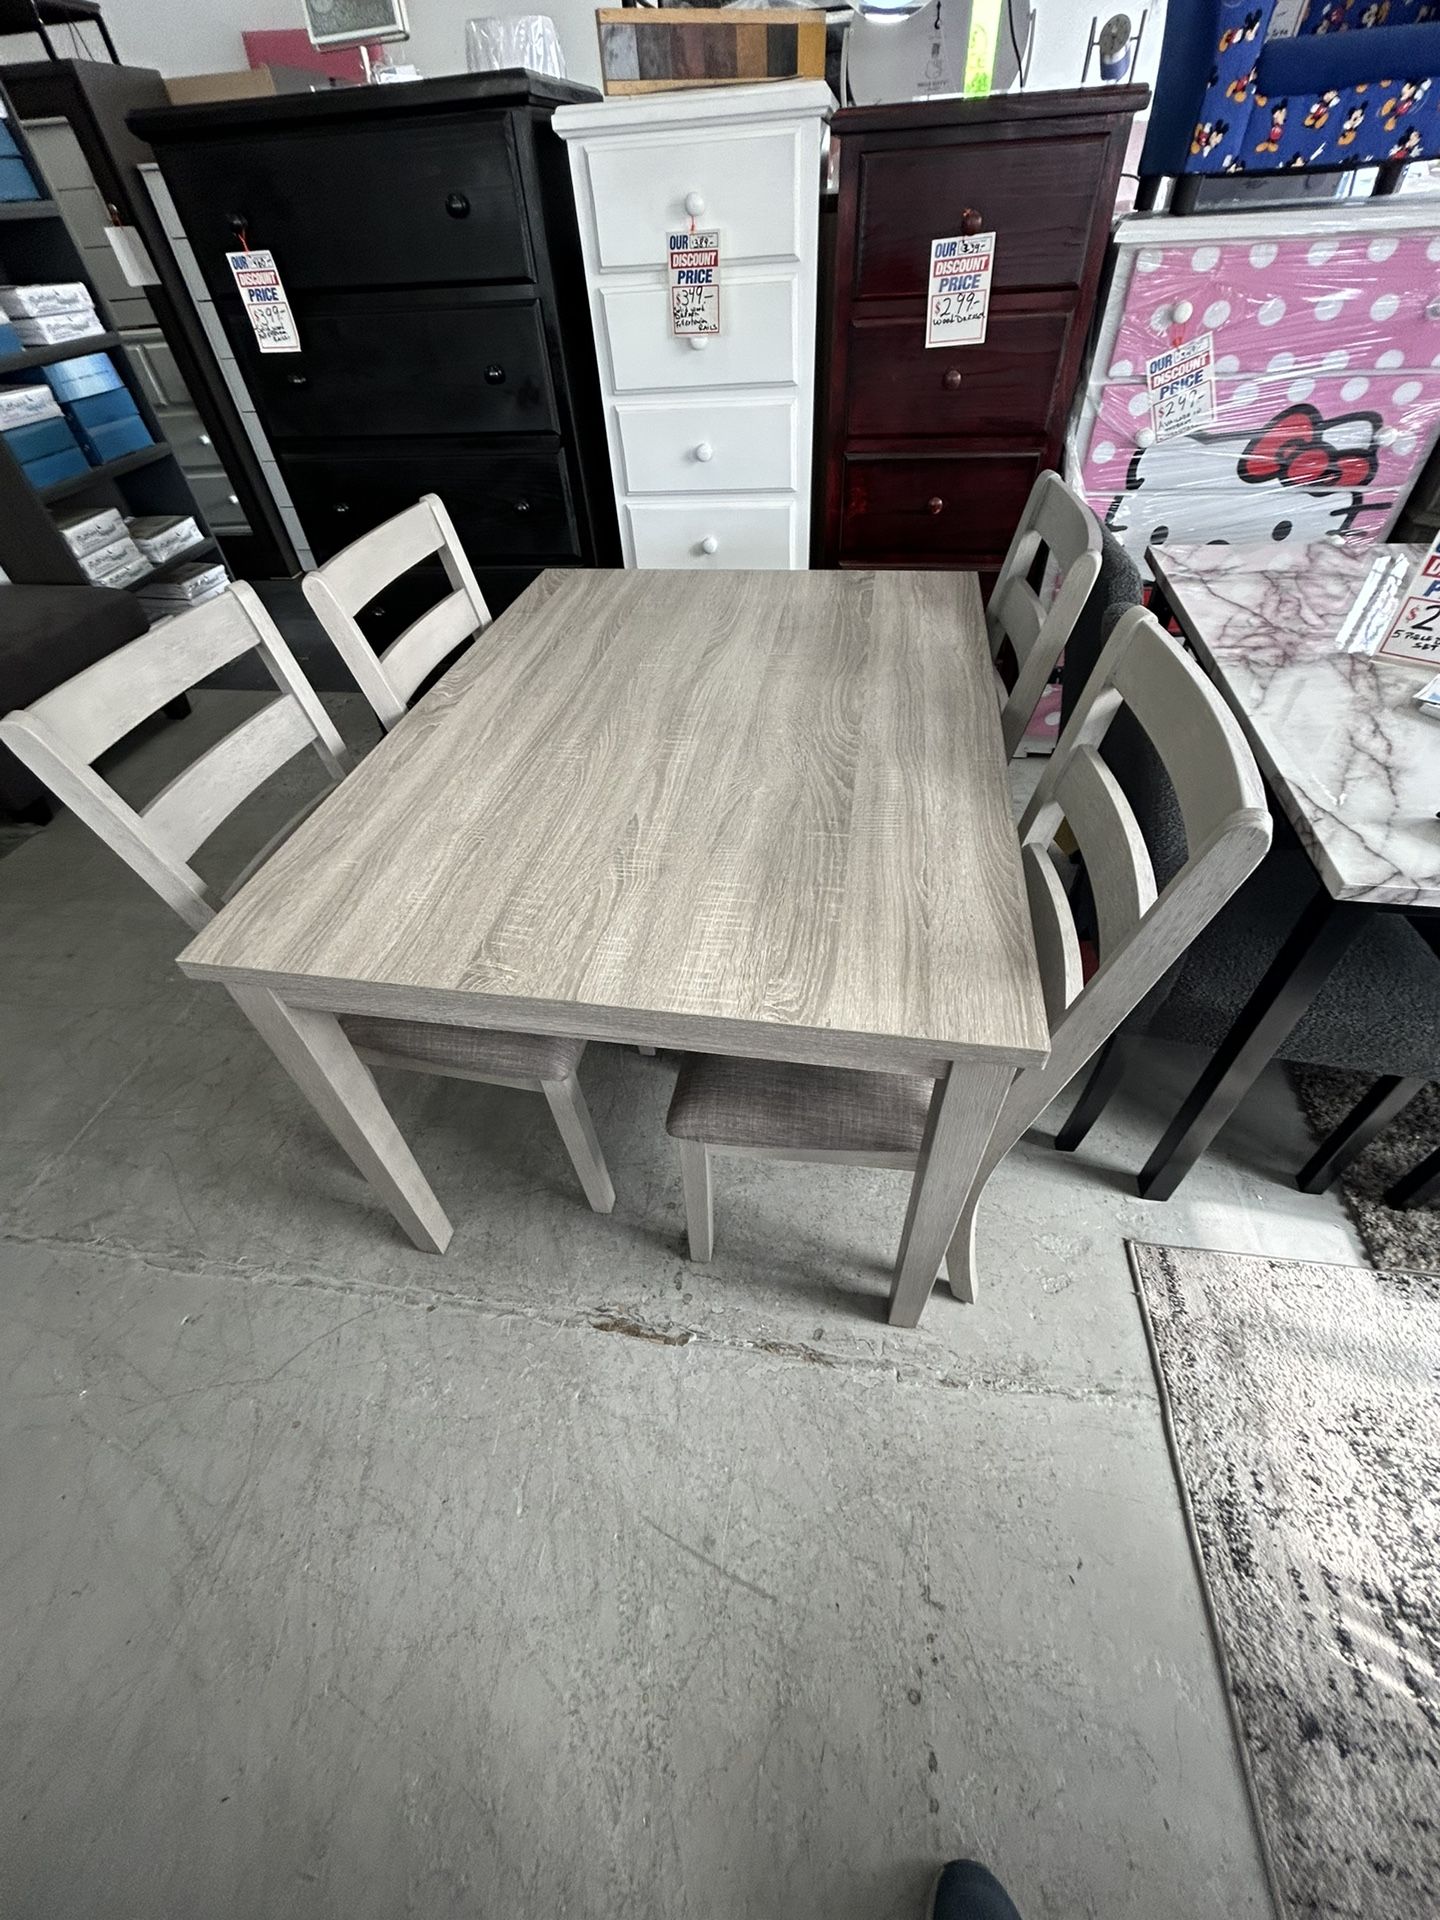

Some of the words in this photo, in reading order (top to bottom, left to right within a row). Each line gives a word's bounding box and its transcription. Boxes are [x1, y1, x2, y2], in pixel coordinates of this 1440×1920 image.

[670, 235, 688, 250] OUR
[935, 241, 957, 258] OUR
[231, 256, 248, 270] OUR
[672, 252, 717, 268] DISCOUNT
[935, 256, 988, 276] DISCOUNT
[238, 272, 278, 286] DISCOUNT
[677, 269, 713, 285] PRICE
[938, 274, 982, 293] PRICE
[248, 288, 279, 302] PRICE
[1150, 353, 1172, 375] OUR
[1153, 355, 1208, 387] DISCOUNT
[1160, 369, 1204, 400] PRICE
